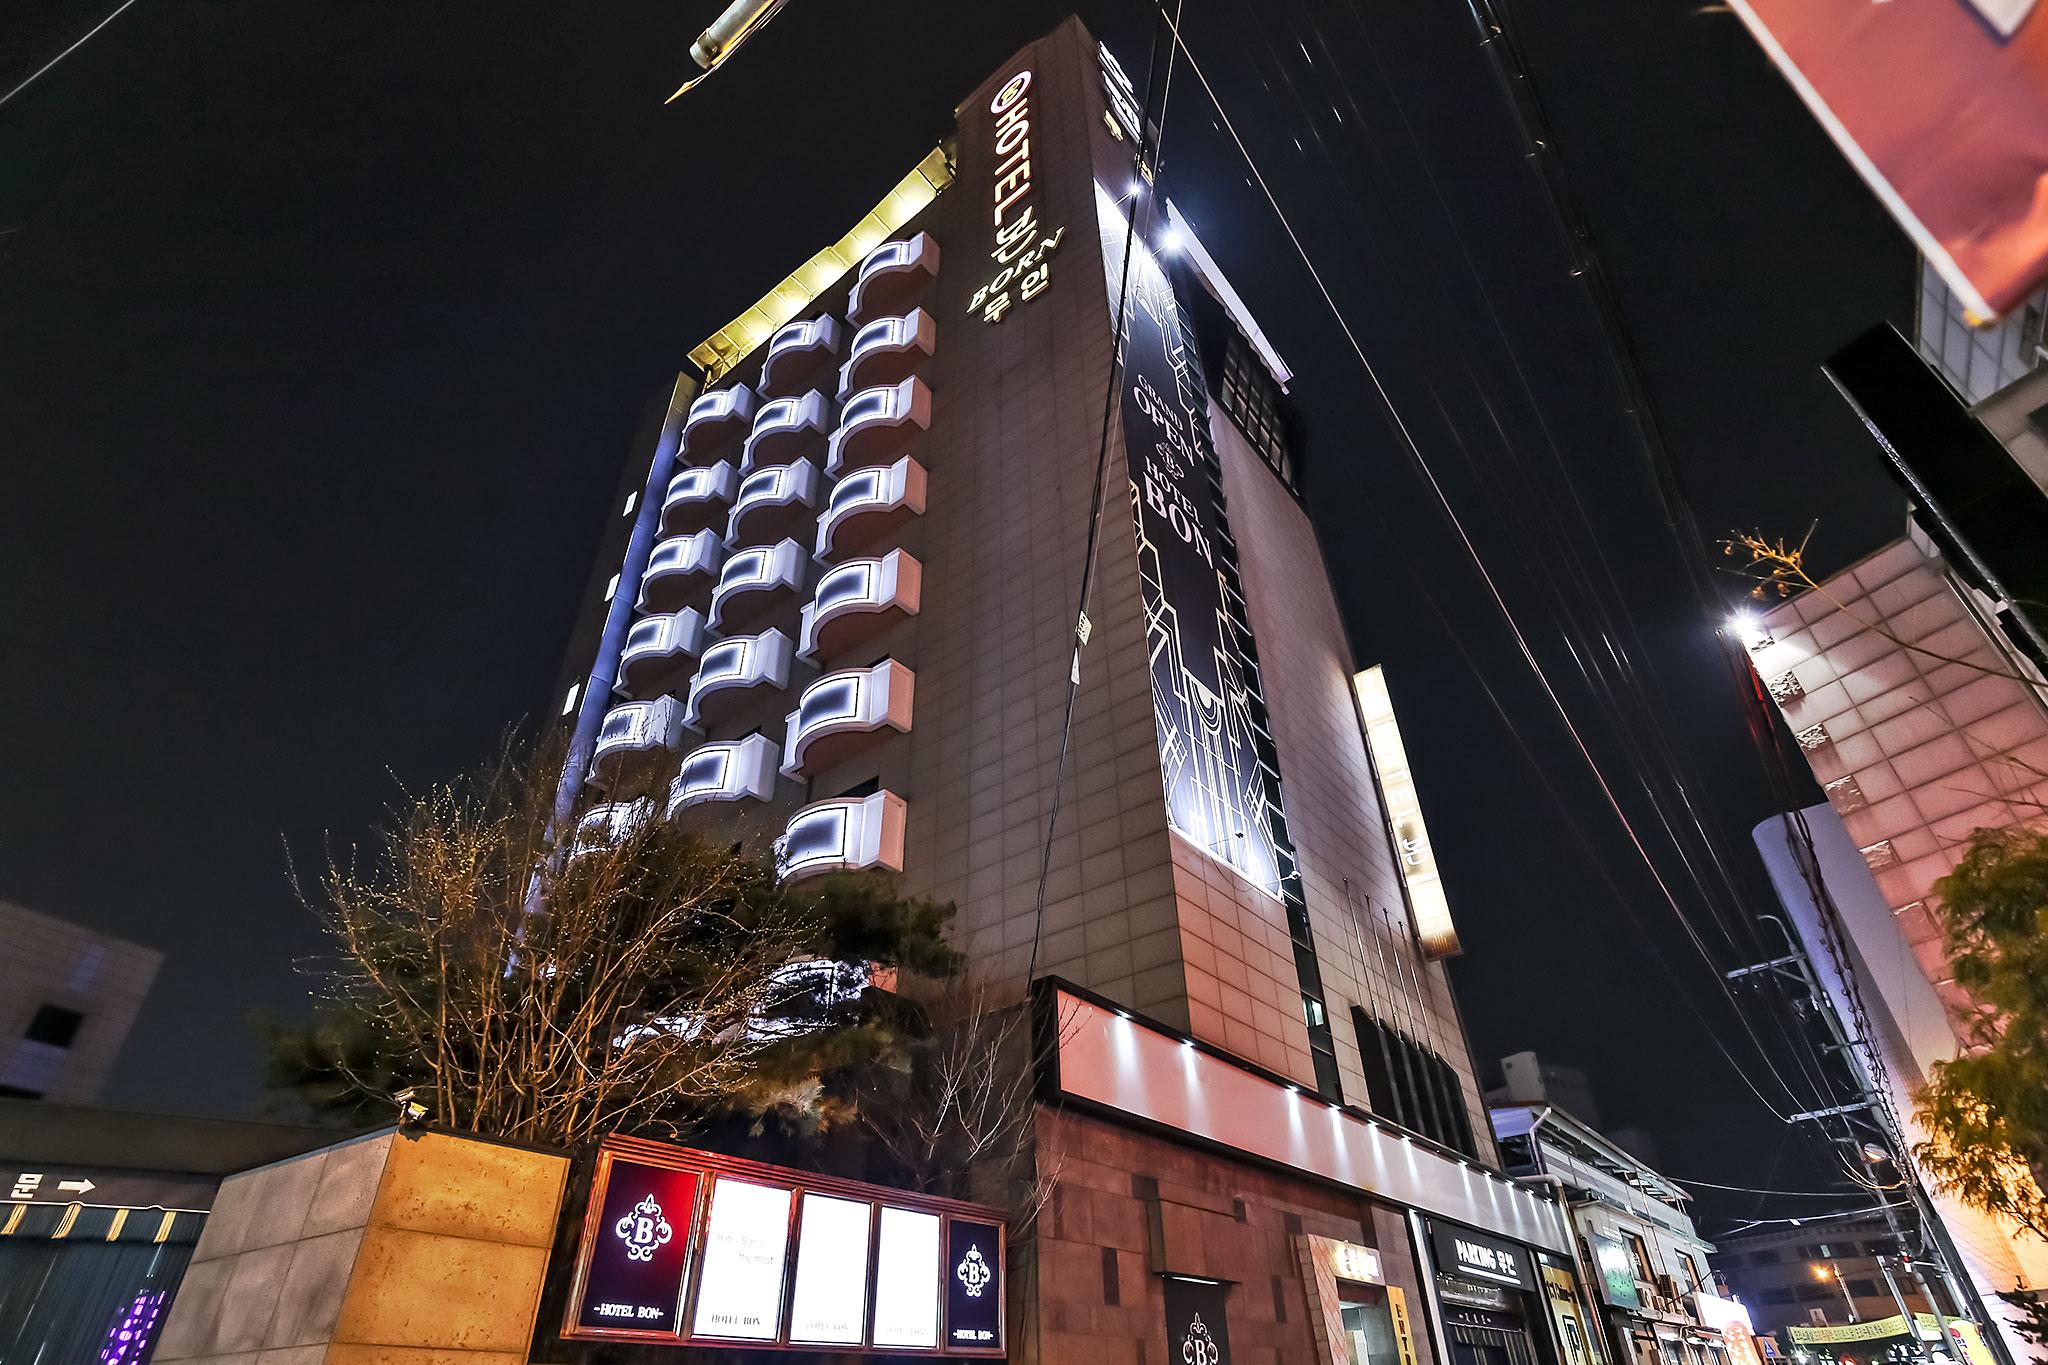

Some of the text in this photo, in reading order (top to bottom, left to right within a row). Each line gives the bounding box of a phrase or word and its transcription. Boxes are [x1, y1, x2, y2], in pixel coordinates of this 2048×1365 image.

[994, 97, 1031, 227] HOTEL
[966, 226, 1064, 313] BORN
[1134, 386, 1194, 466] OPEN
[1143, 471, 1213, 569] BON
[1145, 456, 1203, 528] HOTEL
[10, 1173, 44, 1199] 문
[1455, 1238, 1497, 1270] PARKING
